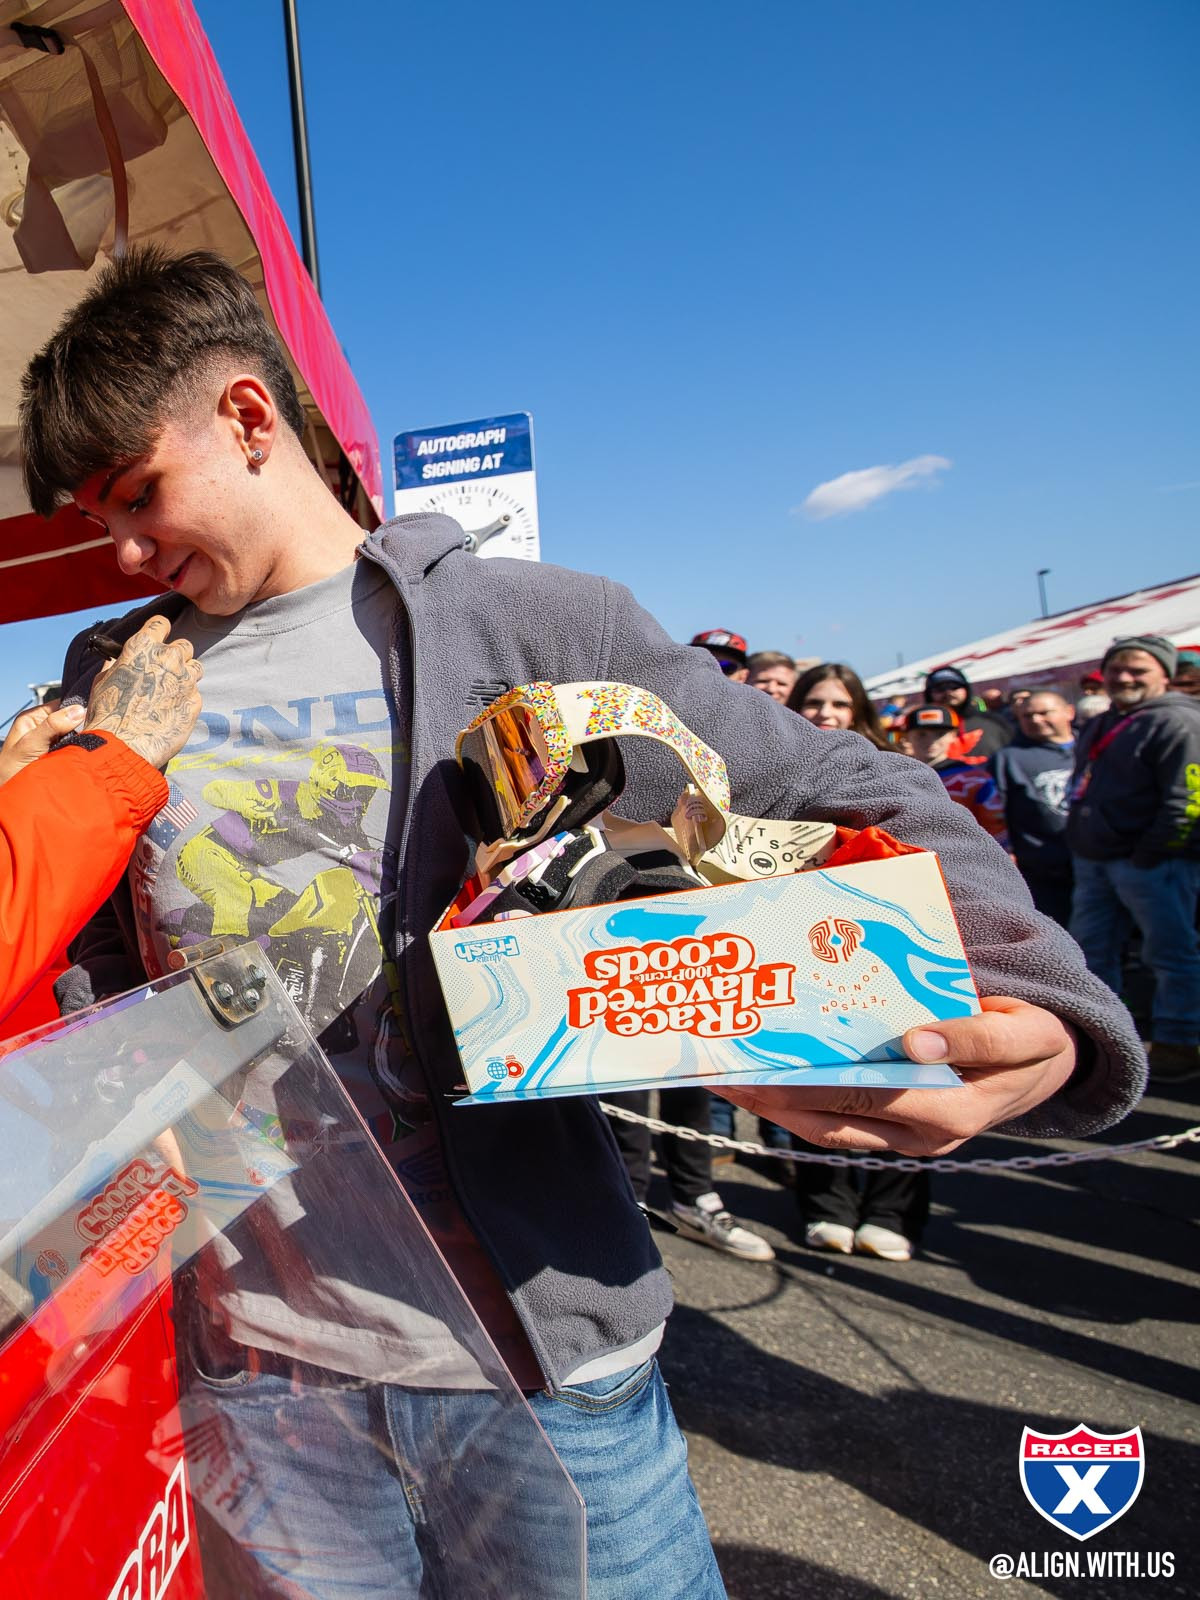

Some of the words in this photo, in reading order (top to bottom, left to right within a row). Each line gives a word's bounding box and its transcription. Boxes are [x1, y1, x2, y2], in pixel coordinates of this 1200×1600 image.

[417, 427, 506, 456] AUTOGRAPH
[422, 457, 480, 480] SIGNING
[481, 453, 504, 471] AT
[455, 937, 519, 961] Fresh
[595, 937, 753, 988] Goods
[812, 965, 879, 993] DONUTS
[578, 967, 792, 1027] Flavored
[822, 995, 887, 1014] JETTSON
[614, 999, 758, 1037] Race
